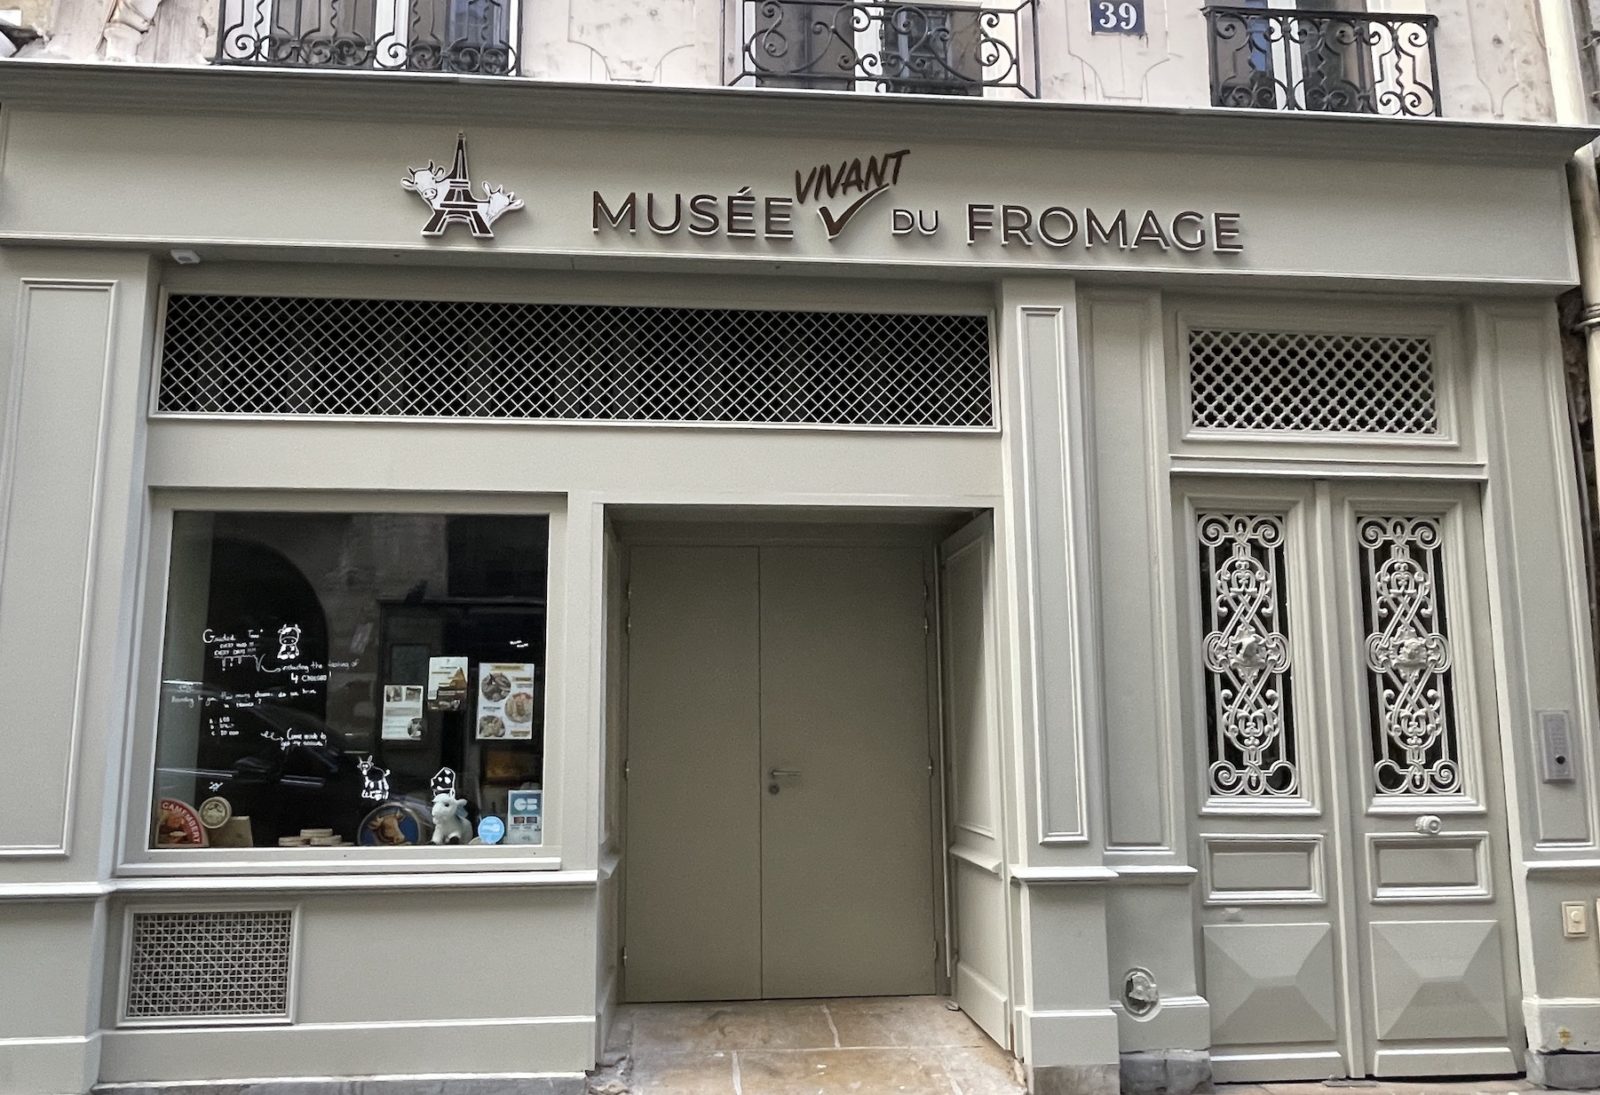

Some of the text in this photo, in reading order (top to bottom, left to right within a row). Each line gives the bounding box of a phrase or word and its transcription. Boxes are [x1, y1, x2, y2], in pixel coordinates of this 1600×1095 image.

[1099, 2, 1137, 30] 39
[795, 149, 910, 204] VIVANT
[592, 186, 1244, 253] MUSÉE DU FROMAGE
[291, 672, 299, 684] 4
[162, 801, 201, 843] CAMEMBERT
